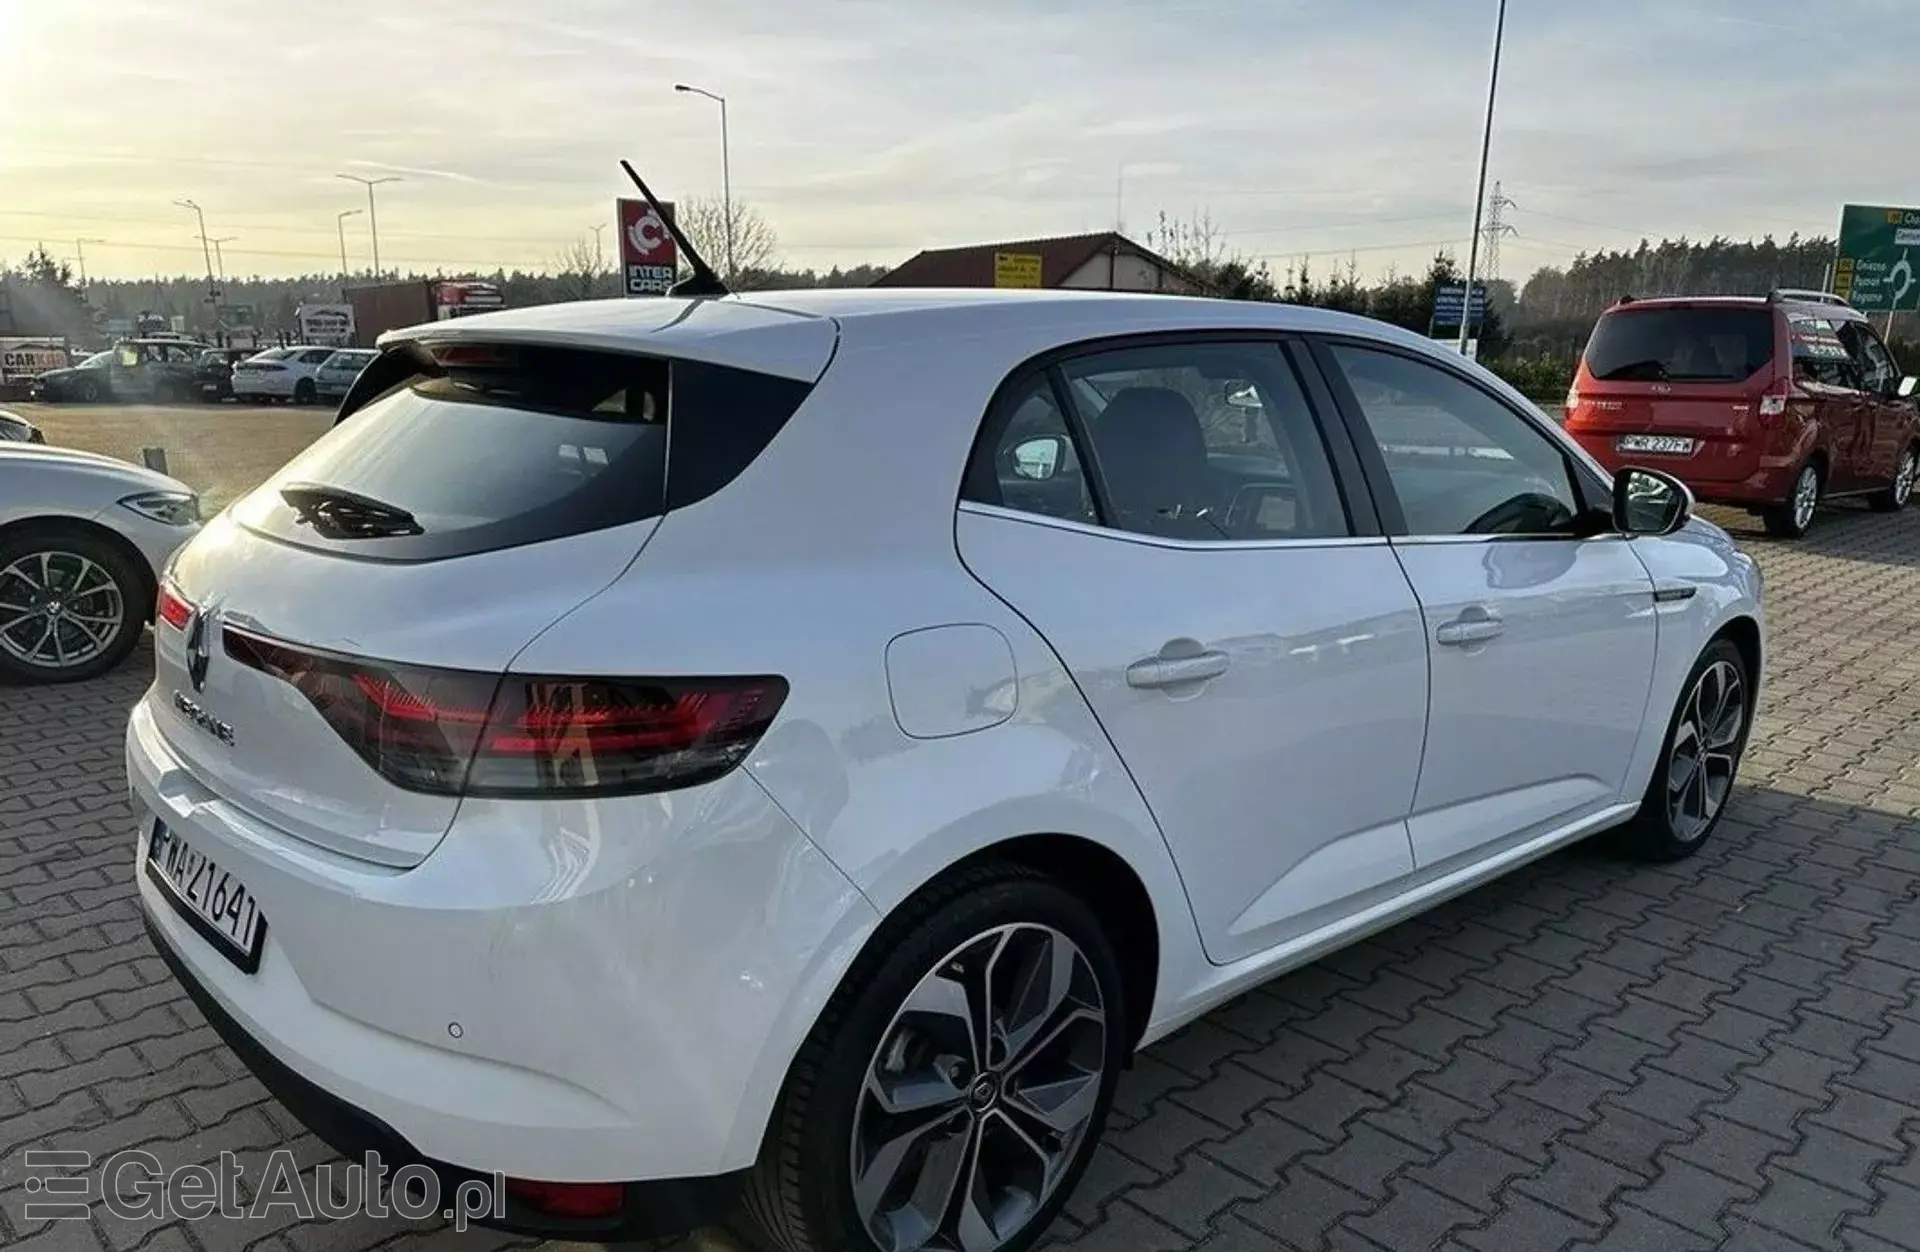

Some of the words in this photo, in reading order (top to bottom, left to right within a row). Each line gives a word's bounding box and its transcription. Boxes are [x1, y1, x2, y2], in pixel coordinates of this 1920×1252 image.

[629, 266, 673, 279] INTER
[630, 279, 672, 292] CARS
[186, 855, 256, 946] 21641
